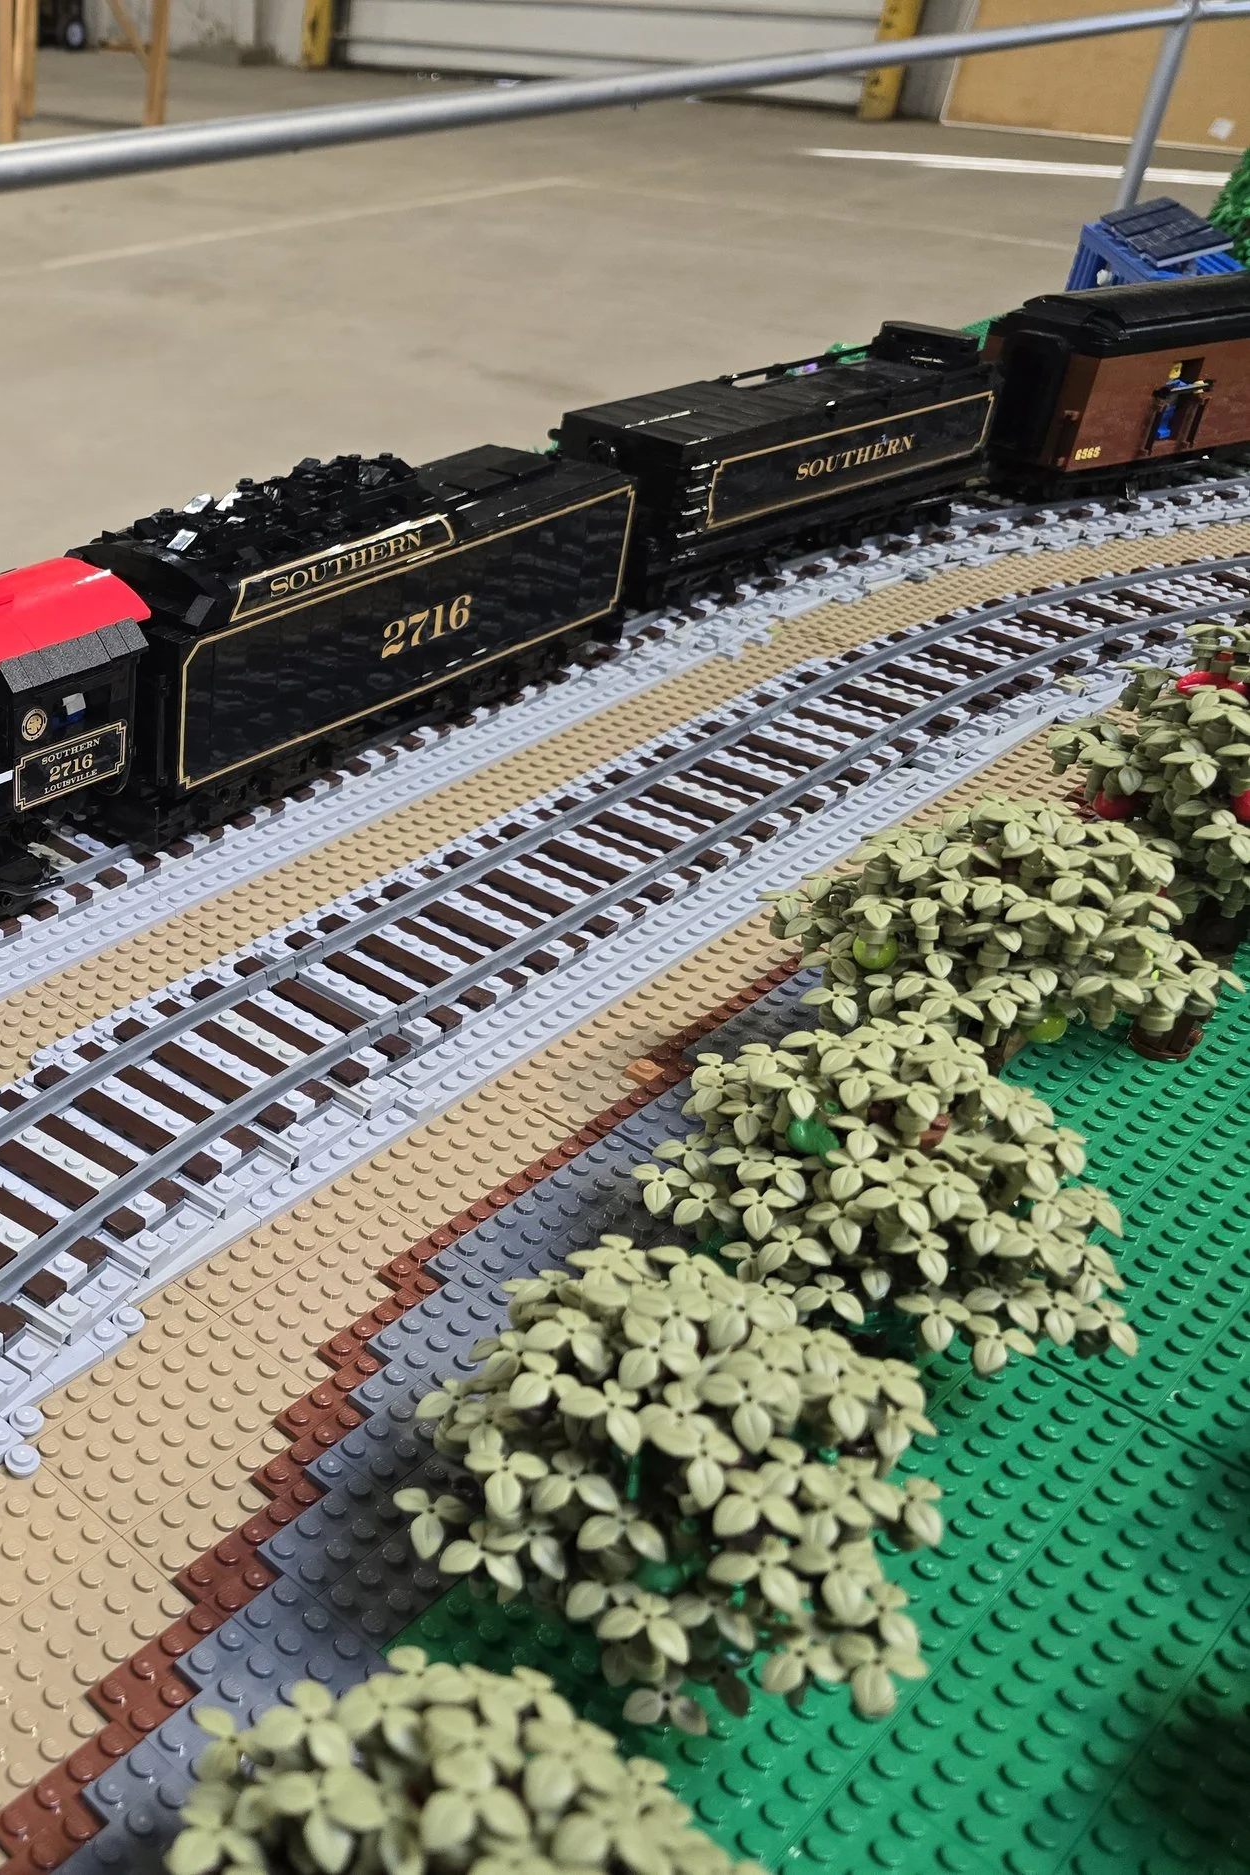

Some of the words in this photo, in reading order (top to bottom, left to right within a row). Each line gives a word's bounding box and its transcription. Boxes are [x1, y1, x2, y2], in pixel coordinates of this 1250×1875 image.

[795, 433, 914, 481] SOUTHERN
[269, 529, 422, 598] SOUTHERN
[381, 594, 473, 660] 2716
[41, 737, 101, 765] SOUTHERN
[49, 753, 94, 783] 2716
[44, 768, 98, 794] LOUISVILLE
